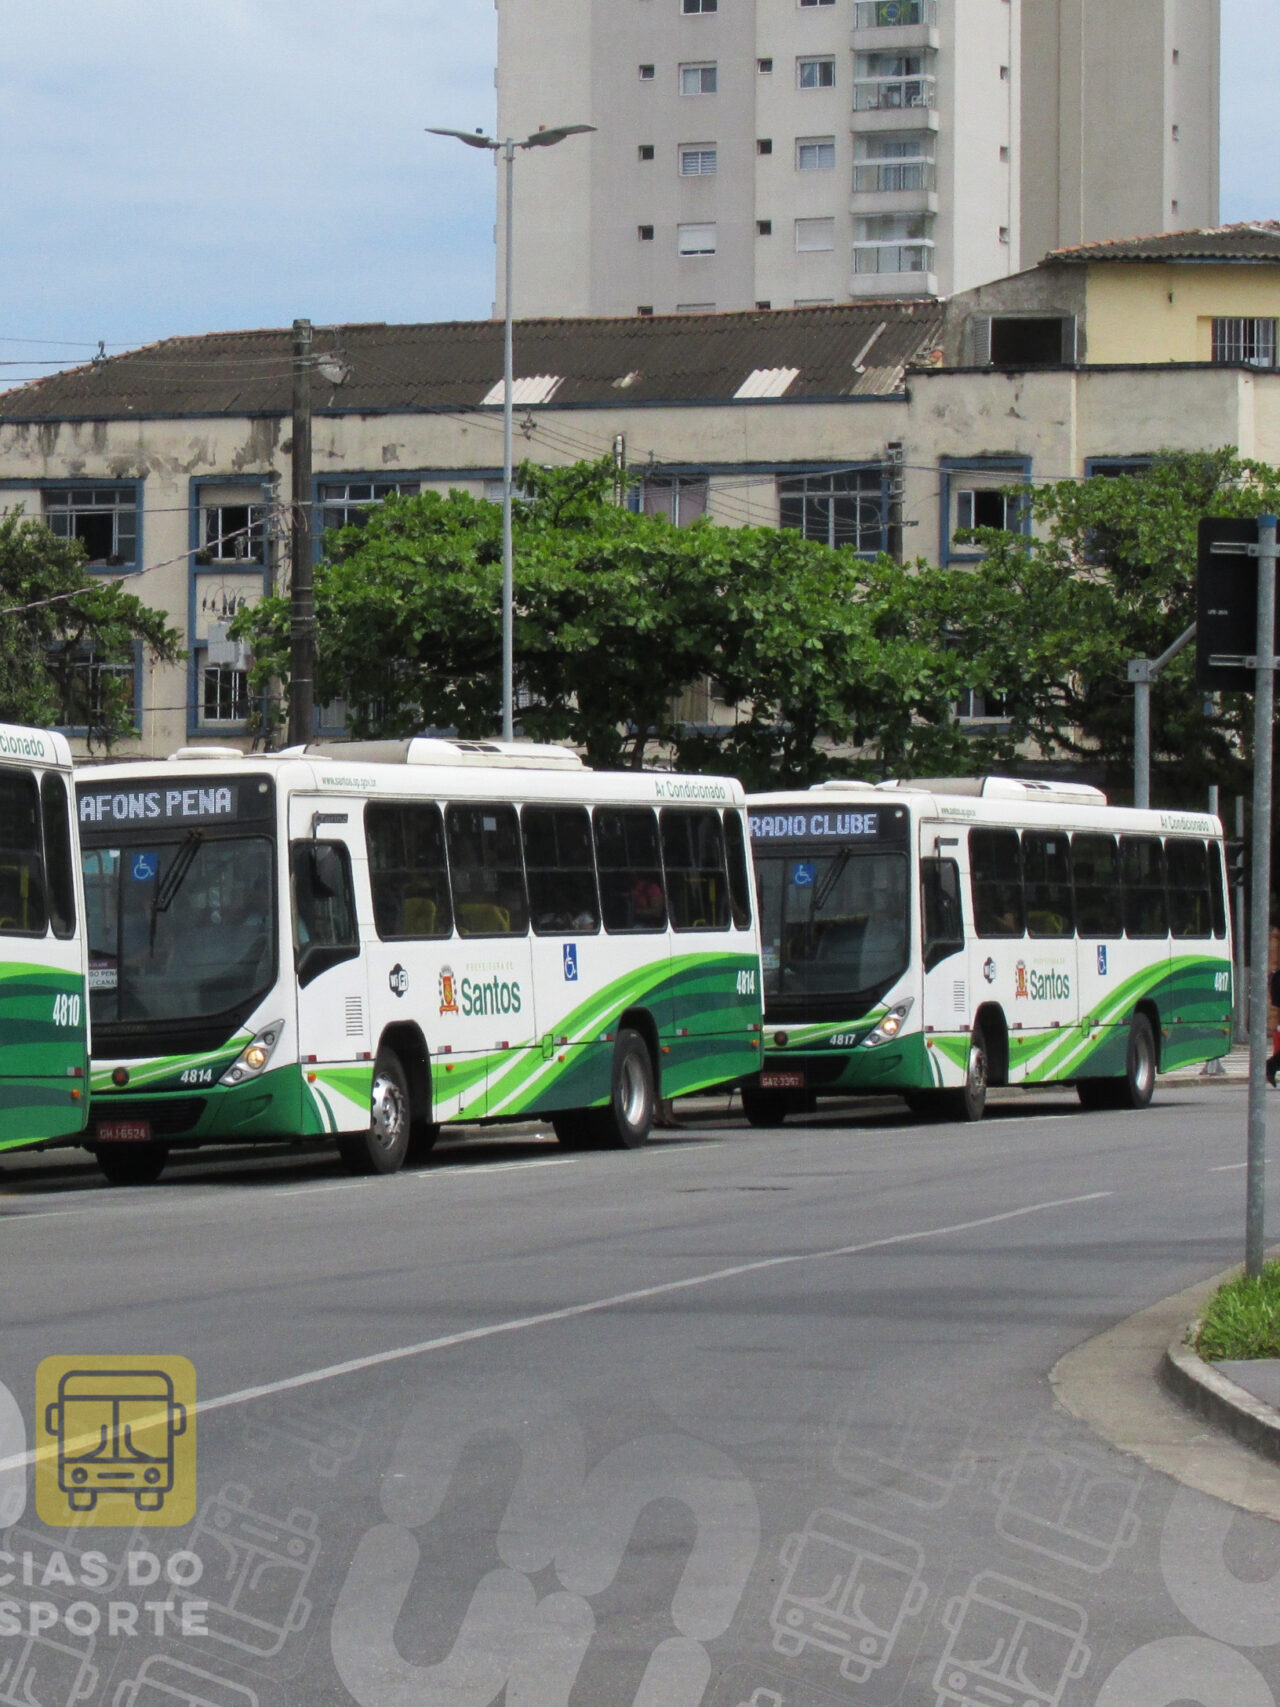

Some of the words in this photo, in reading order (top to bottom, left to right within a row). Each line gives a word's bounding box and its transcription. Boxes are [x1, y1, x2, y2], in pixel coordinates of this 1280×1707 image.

[666, 780, 726, 800] Condicionado
[80, 791, 161, 822] AFONS
[166, 788, 232, 817] PENA
[750, 816, 806, 837] RADIO
[810, 813, 877, 835] CLUBE
[737, 970, 755, 995] 4814
[1030, 968, 1070, 1000] Santos
[461, 975, 521, 1017] Santos
[53, 994, 80, 1027] 4810
[829, 1033, 856, 1045] 4817
[181, 1068, 212, 1083] 4814
